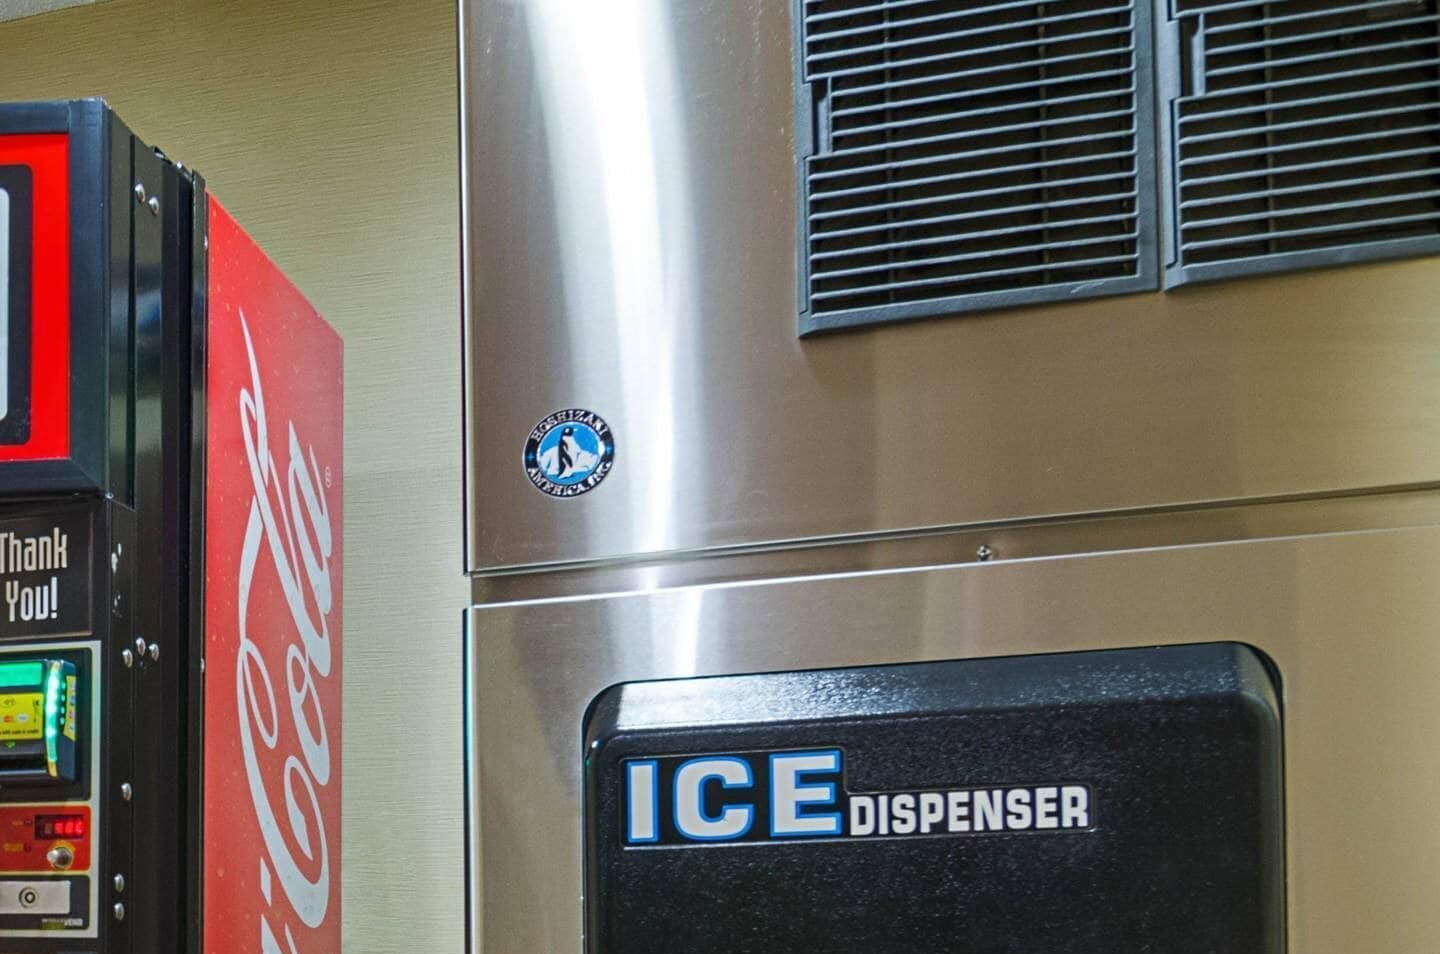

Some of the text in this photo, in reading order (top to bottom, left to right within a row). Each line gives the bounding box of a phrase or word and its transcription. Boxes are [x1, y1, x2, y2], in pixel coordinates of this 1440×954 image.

[531, 410, 609, 442] HOSHIZAKI
[5, 576, 58, 622] You!
[626, 749, 1089, 843] ICE DISPENSER
